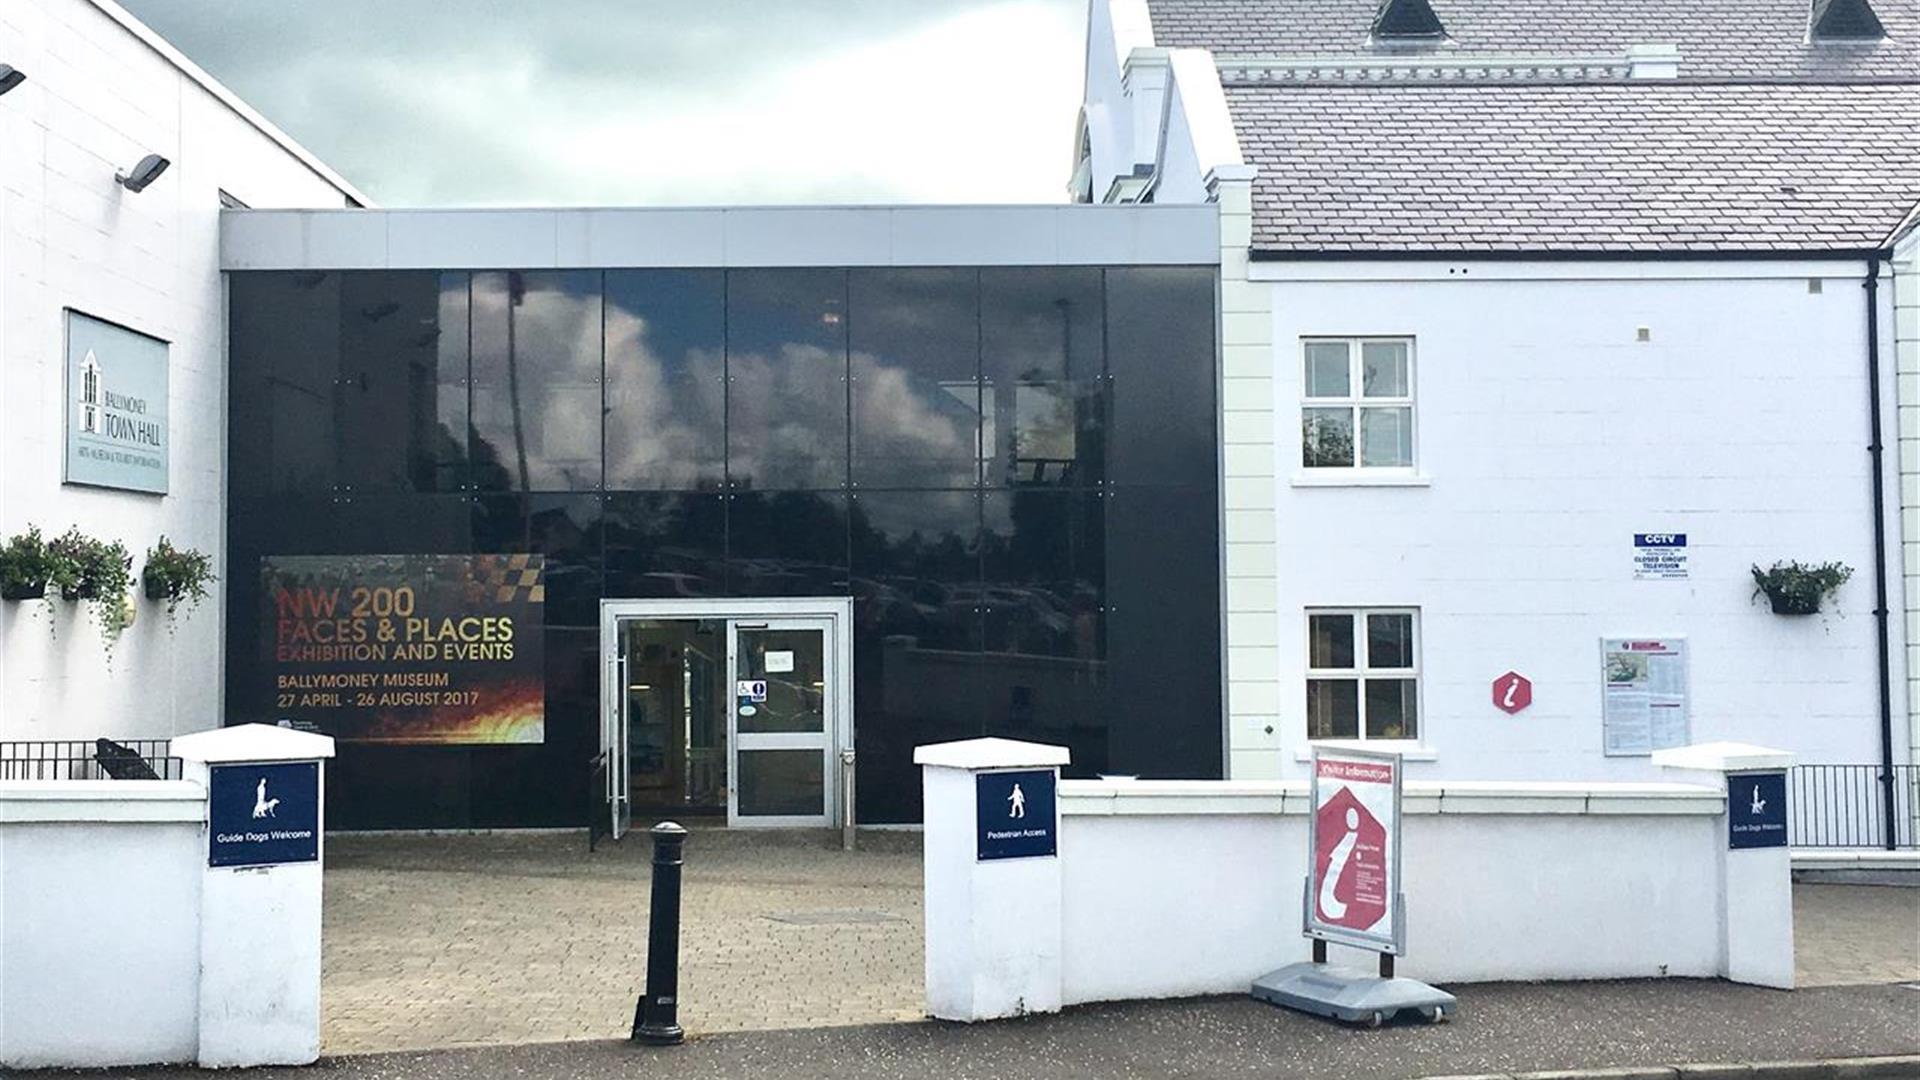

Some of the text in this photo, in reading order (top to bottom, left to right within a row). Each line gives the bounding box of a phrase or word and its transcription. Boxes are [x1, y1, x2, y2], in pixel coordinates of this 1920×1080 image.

[105, 390, 146, 415] BALLYMONEY
[105, 413, 160, 446] TOWN HALL
[1645, 534, 1676, 544] CCTV
[278, 586, 415, 618] NW 200
[279, 617, 513, 643] FACES & PLACES
[277, 643, 514, 662] EXHIBITION AND EVENTS
[278, 672, 449, 689] BALLYMONEY MUSEUM
[278, 694, 295, 708] 27
[300, 693, 342, 707] APRIL
[357, 692, 376, 706] 26
[379, 692, 440, 706] AUGUST
[444, 691, 480, 706] 2017
[217, 830, 312, 843] Guide Dogs Welcome
[987, 829, 1046, 840] Pedestrian Access
